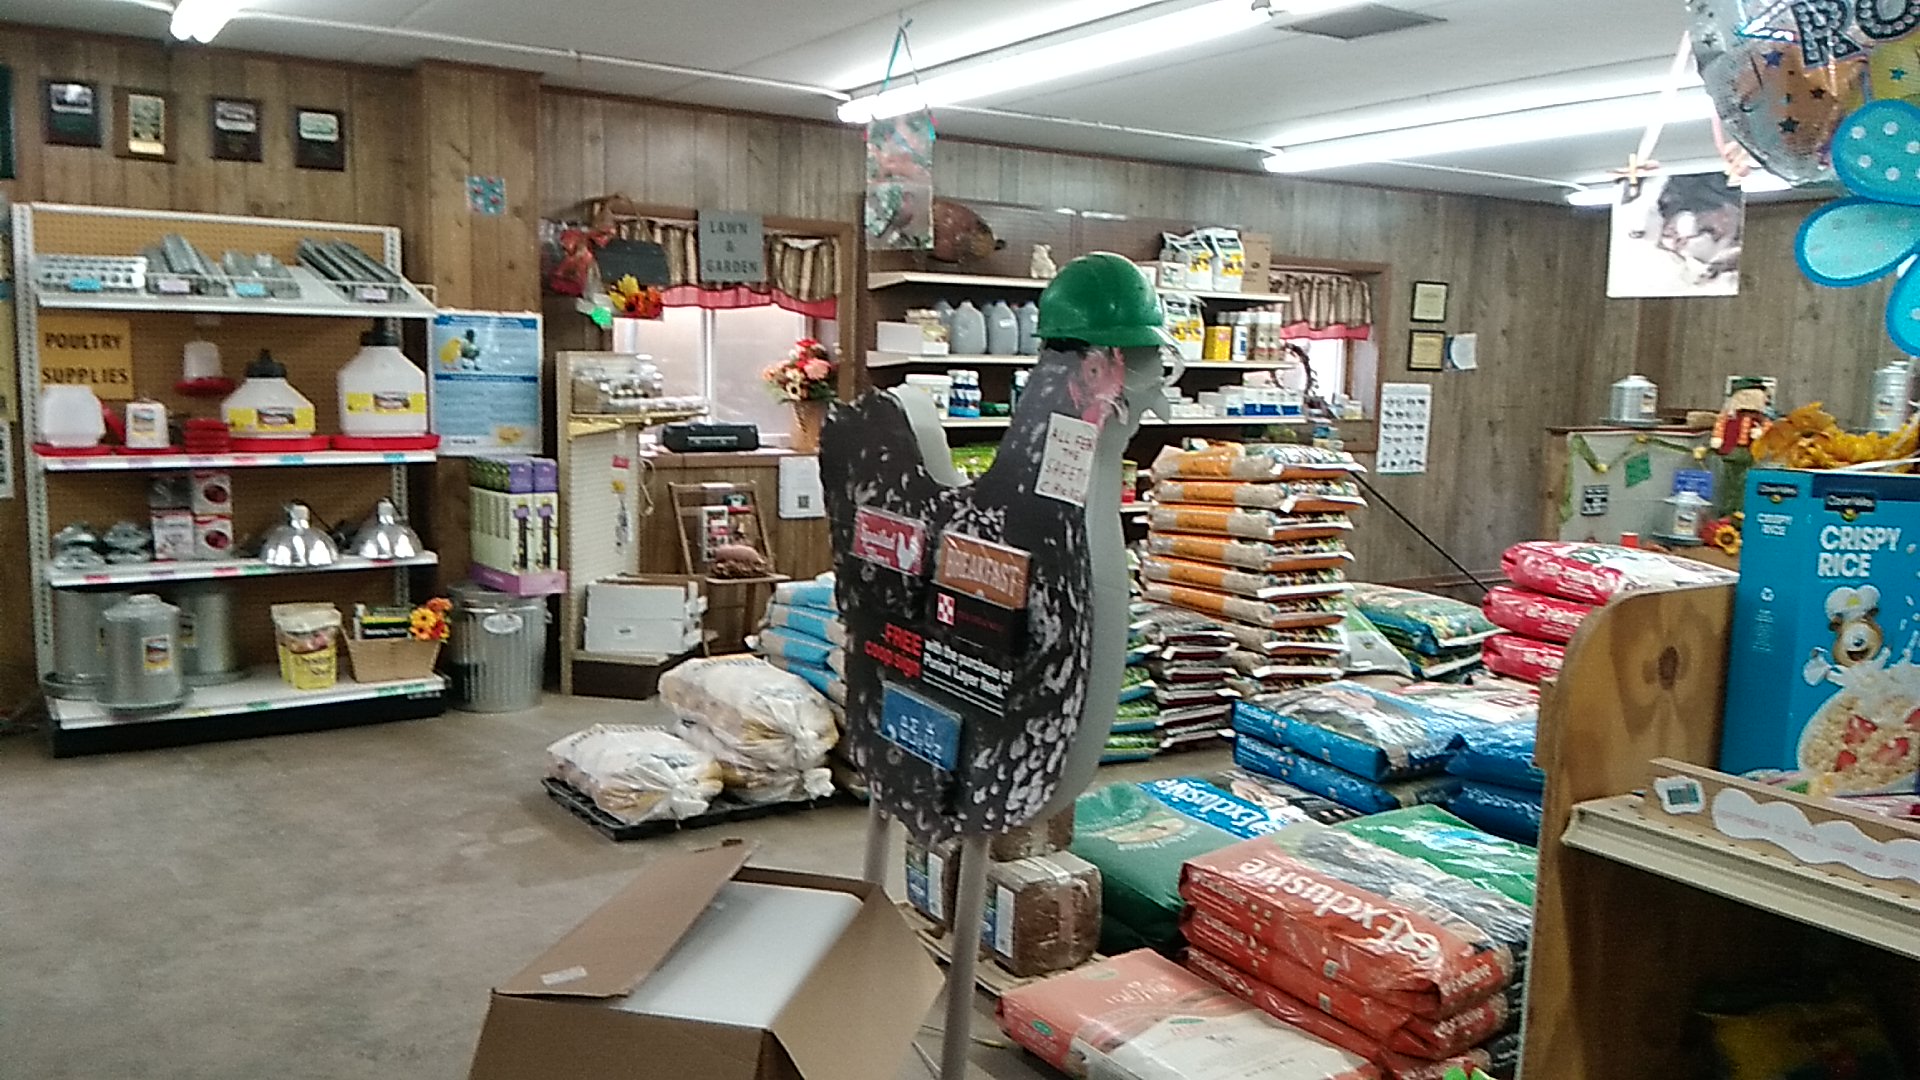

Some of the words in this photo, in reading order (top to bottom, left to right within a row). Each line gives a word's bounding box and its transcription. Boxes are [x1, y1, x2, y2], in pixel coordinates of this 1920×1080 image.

[709, 221, 748, 235] LAWN
[726, 240, 735, 253] &
[705, 259, 757, 275] GARDEN
[45, 332, 122, 350] POULTRY
[42, 367, 128, 384] SUPPLIES
[1756, 513, 1794, 526] CRISPY
[1761, 524, 1787, 537] RICE
[1819, 525, 1902, 551] CRISPY
[944, 546, 1020, 599] BREAKFAST
[1817, 552, 1873, 578] RICE
[884, 621, 923, 658] FREE
[893, 652, 923, 679] sign
[924, 638, 943, 656] with
[943, 644, 958, 661] the
[958, 653, 1000, 681] purchase
[1001, 670, 1014, 685] of
[953, 664, 979, 688] Layer
[1154, 778, 1266, 828] Exclusive
[1239, 856, 1407, 944] Exclusive
